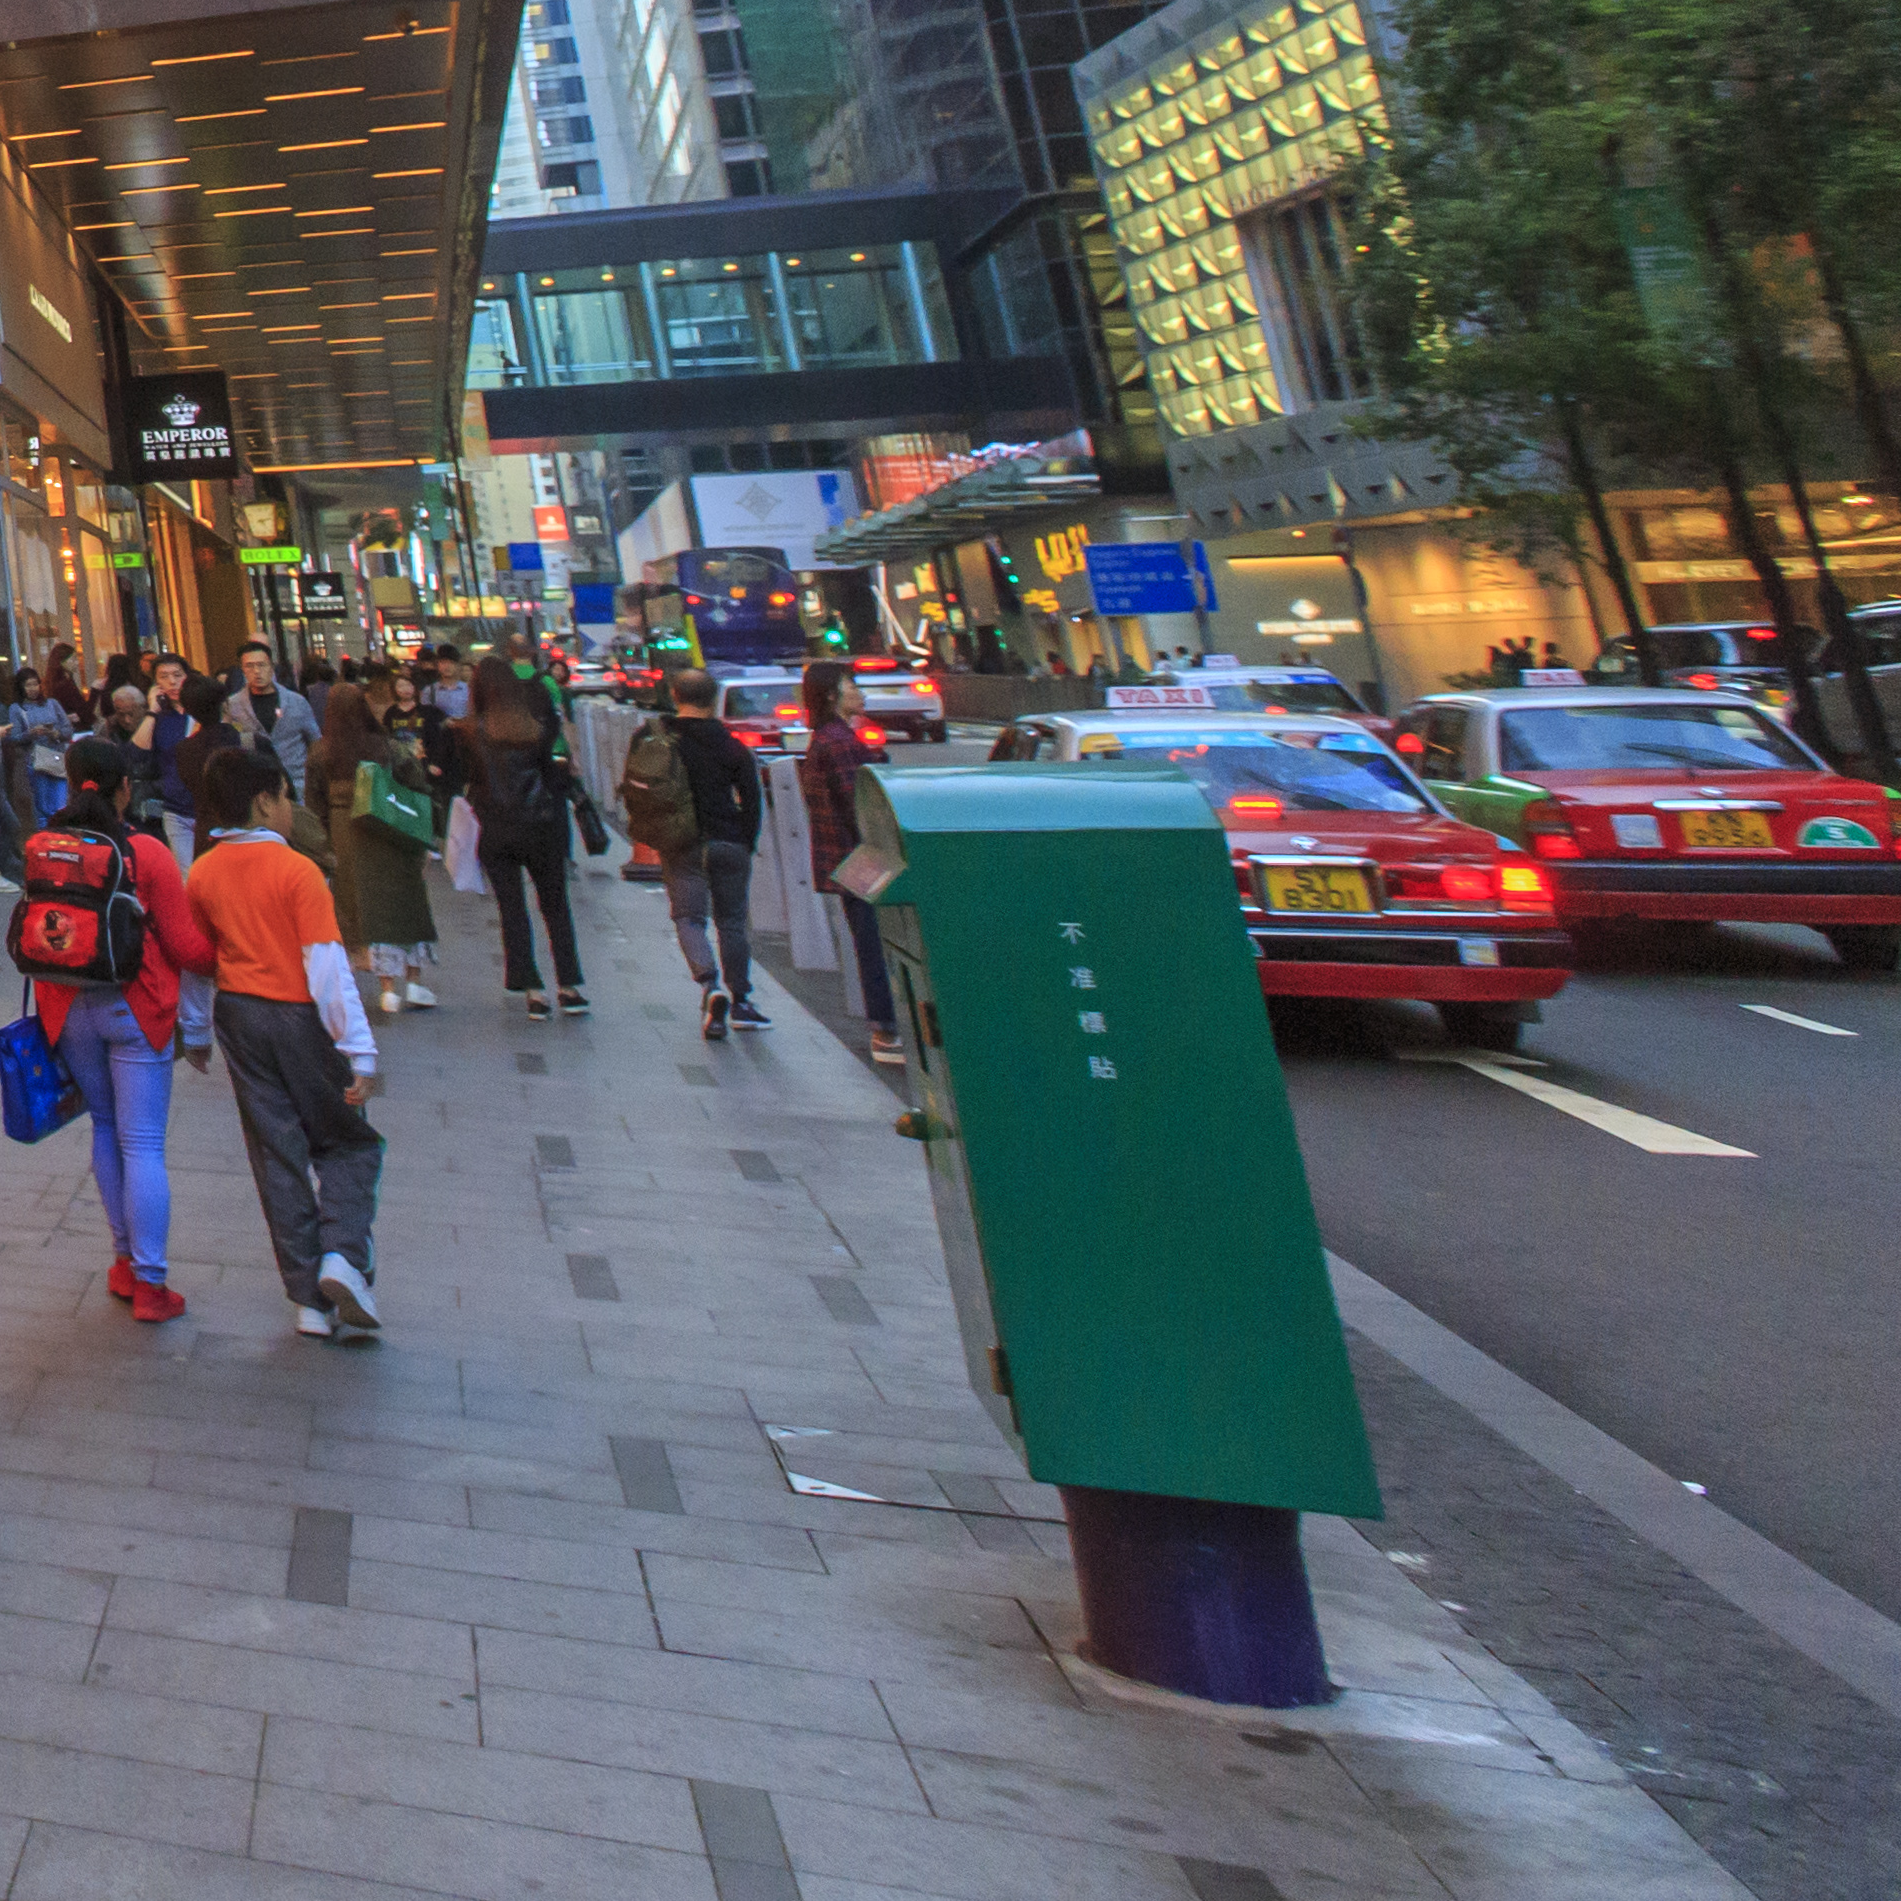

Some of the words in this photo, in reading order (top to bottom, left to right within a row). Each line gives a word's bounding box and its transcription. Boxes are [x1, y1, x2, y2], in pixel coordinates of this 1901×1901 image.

[142, 427, 229, 444] EMPEROR
[243, 550, 299, 561] ROLEX
[1114, 688, 1206, 704] TAXI
[1296, 867, 1331, 889] SY
[1285, 888, 1357, 910] 8301
